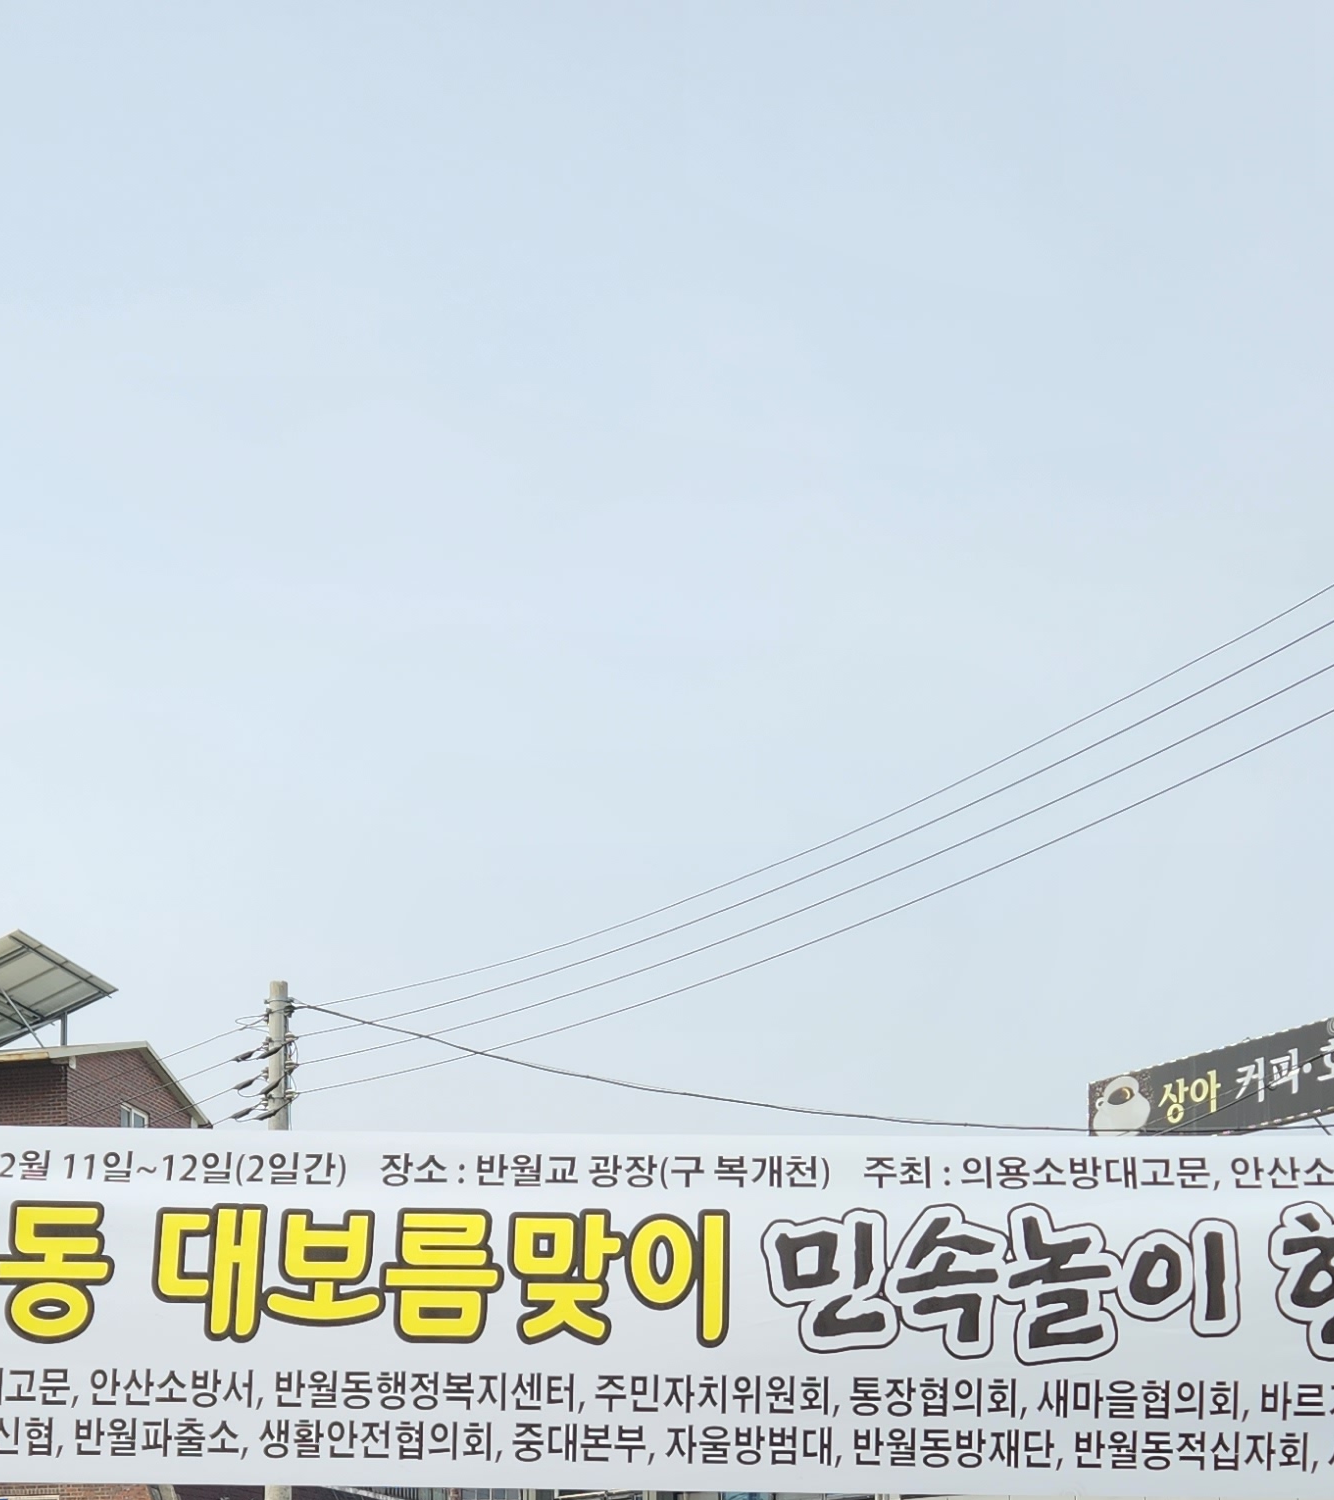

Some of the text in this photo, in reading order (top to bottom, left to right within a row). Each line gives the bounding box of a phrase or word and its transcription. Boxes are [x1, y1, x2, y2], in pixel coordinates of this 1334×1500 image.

[1158, 1069, 1221, 1124] 상아
[0, 1150, 50, 1182] 2월
[380, 1153, 449, 1185] 장소
[476, 1154, 579, 1187] 반월교
[714, 1155, 832, 1191] 복개천)
[863, 1156, 933, 1189] 주최
[961, 1156, 1221, 1191] 의용소방대고문,
[151, 1202, 731, 1348] 대보름맞이
[761, 1202, 1240, 1367] 민속놀이
[89, 1367, 263, 1411] 안산소방서,
[274, 1370, 585, 1414] 반월동행정복지센터,
[594, 1374, 843, 1418] 주민자치위원회,
[849, 1376, 1029, 1420] 통장협의회,
[1037, 1378, 1249, 1423] 새마을협의회,
[73, 1418, 249, 1461] 반월파출소,
[258, 1419, 503, 1463] 생활안전협의회,
[512, 1422, 655, 1465] 중대본부,
[853, 1427, 1063, 1471] 반월동방재단,
[1073, 1430, 1319, 1473] 반월동적십자회,
